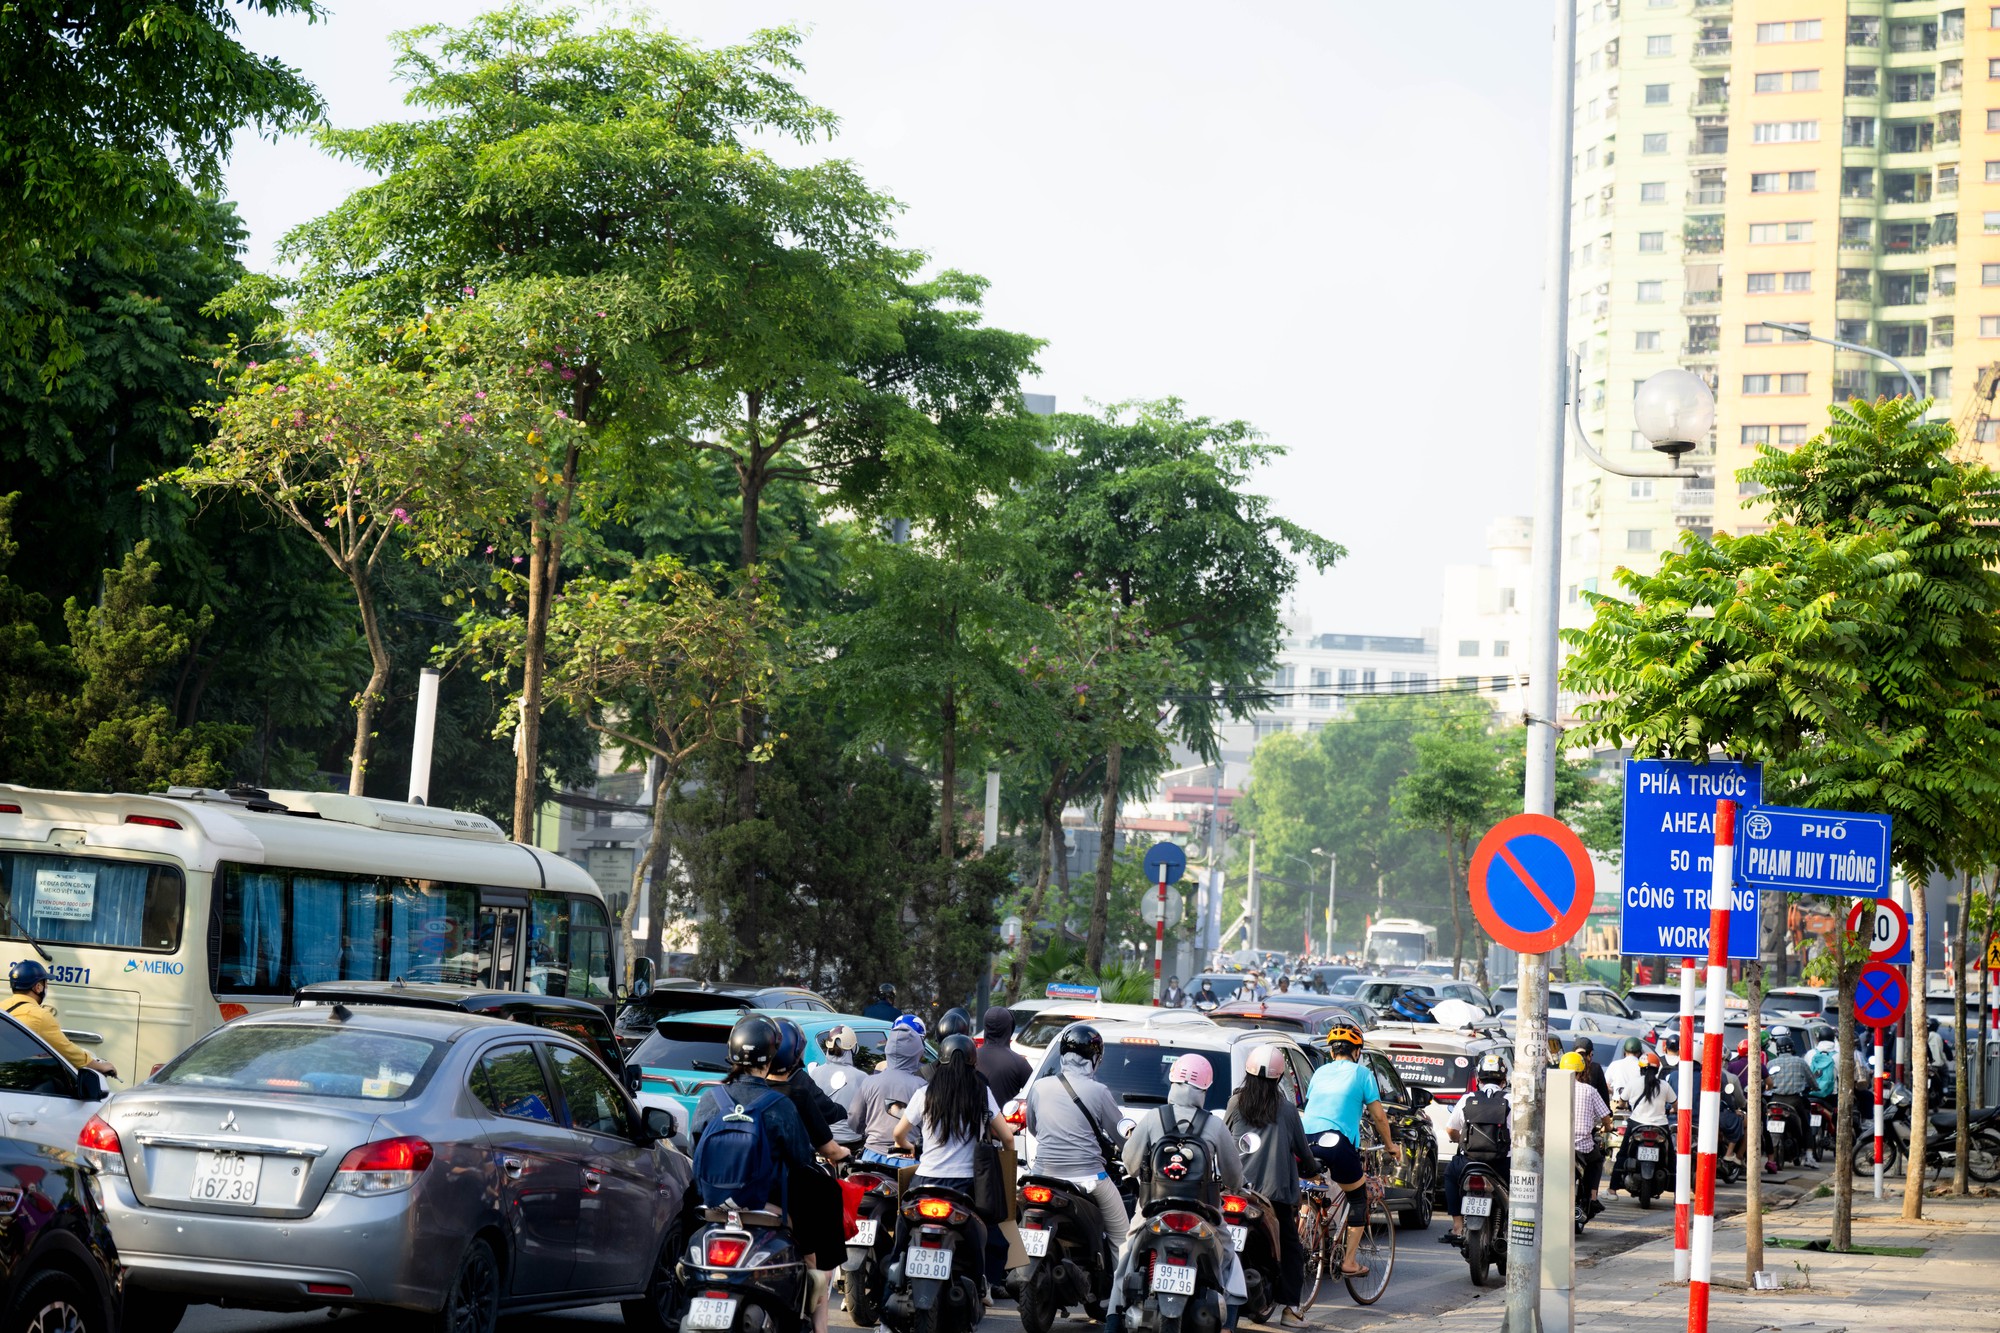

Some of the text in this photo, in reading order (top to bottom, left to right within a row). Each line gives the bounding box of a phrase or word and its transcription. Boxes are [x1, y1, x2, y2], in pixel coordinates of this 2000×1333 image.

[1639, 768, 1746, 797] PHÍA TRƯỚC
[1661, 811, 1717, 834] AHEA
[1801, 820, 1848, 840] PHỐ
[1670, 849, 1713, 872] 50 m
[1748, 847, 1876, 884] PHẠM HUY THÔNG
[1627, 881, 1675, 909] CÔNG
[1683, 888, 1755, 912] TRNG
[142, 960, 184, 975] MEIKO
[211, 1156, 245, 1177] 30G
[197, 1177, 254, 1201] 167.38
[914, 1249, 945, 1264] 29-AB
[909, 1262, 947, 1278] 903.80
[1160, 1265, 1190, 1280] 99-H1
[1155, 1277, 1192, 1294] 307.96
[697, 1300, 729, 1314] 29-B1
